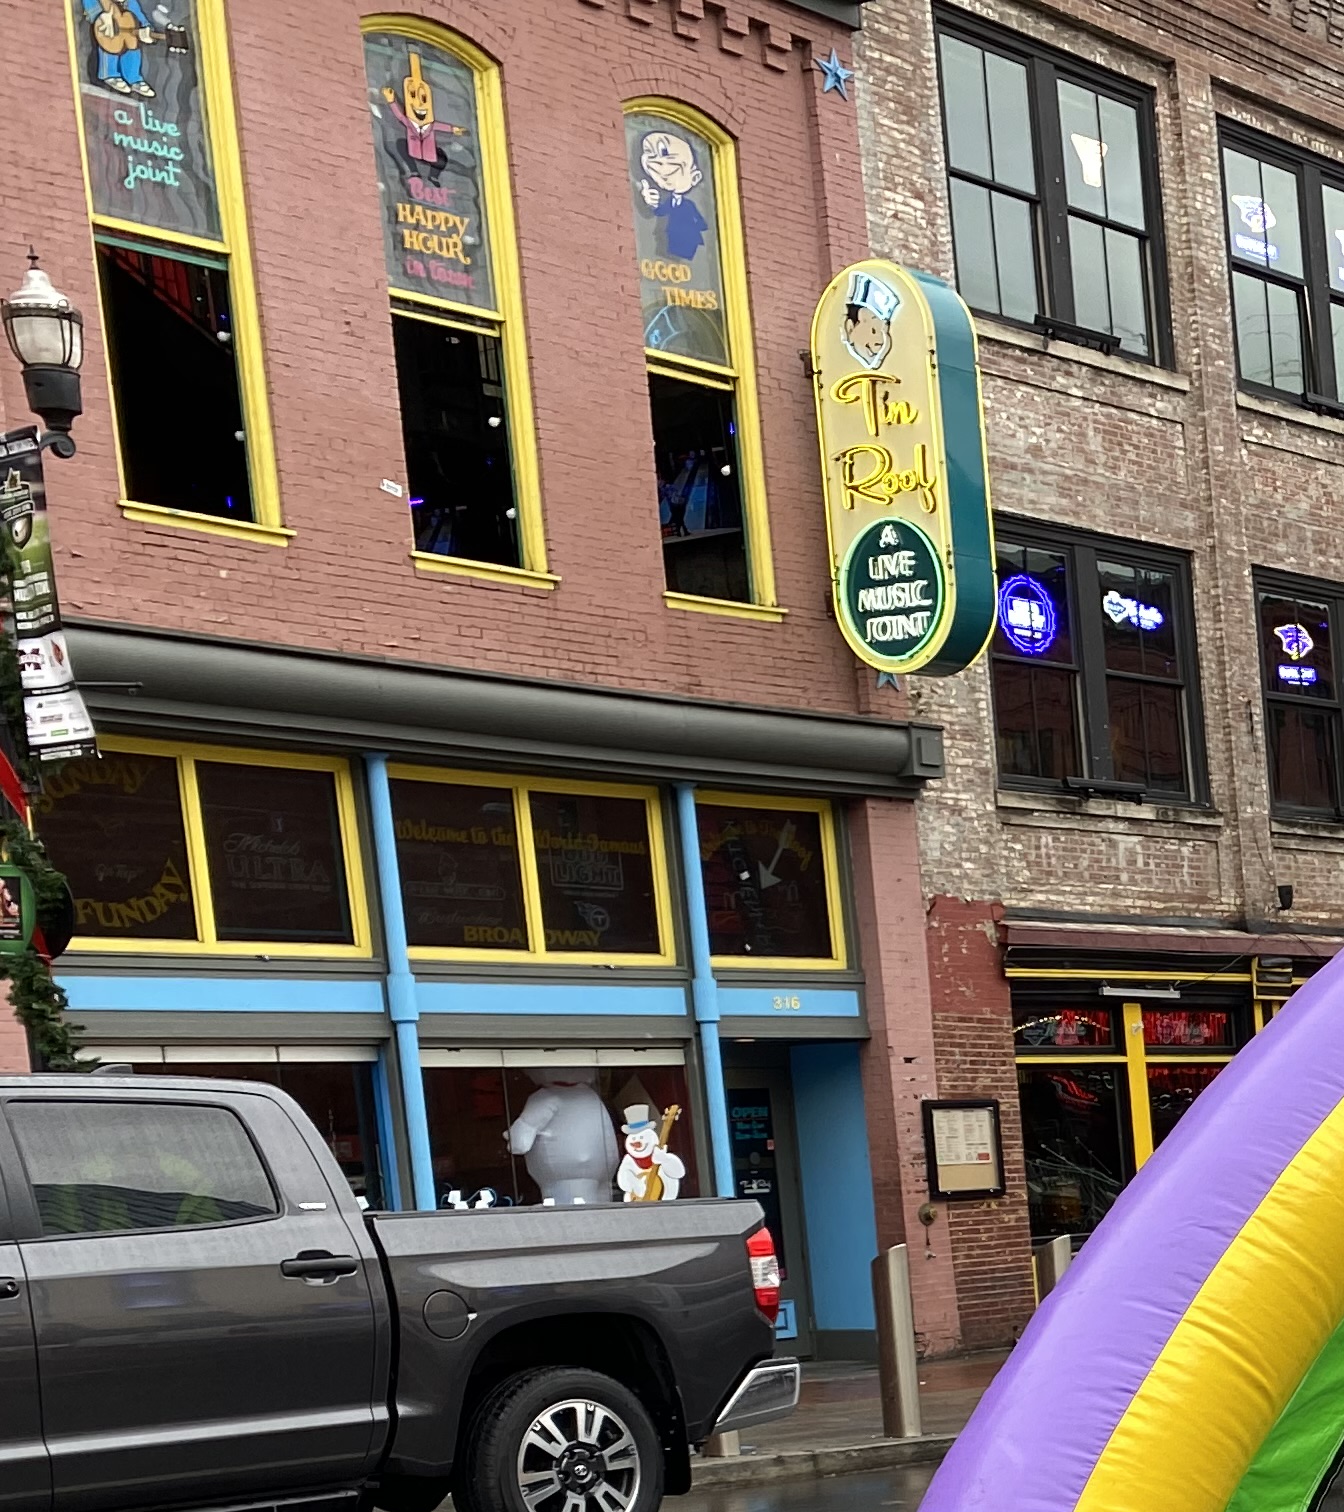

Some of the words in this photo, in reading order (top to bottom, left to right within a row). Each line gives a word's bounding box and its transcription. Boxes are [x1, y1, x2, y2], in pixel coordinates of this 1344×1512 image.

[113, 108, 133, 125] a
[138, 102, 181, 137] live
[112, 130, 184, 161] music
[123, 155, 182, 189] joint
[396, 203, 470, 238] HAPPY
[402, 229, 471, 265] HOUR
[641, 259, 692, 283] GOOD
[661, 286, 719, 310] TIMES
[829, 370, 919, 437] Tin
[831, 443, 936, 513] Roof
[879, 524, 900, 549] A
[868, 551, 917, 581] LIVE
[857, 579, 934, 613] MUSIC
[863, 610, 931, 643] JOINT
[396, 818, 469, 844] Welcome
[470, 826, 488, 844] to
[225, 854, 331, 883] ULTRA
[75, 857, 189, 928] FUNDAY
[773, 996, 800, 1010] 316
